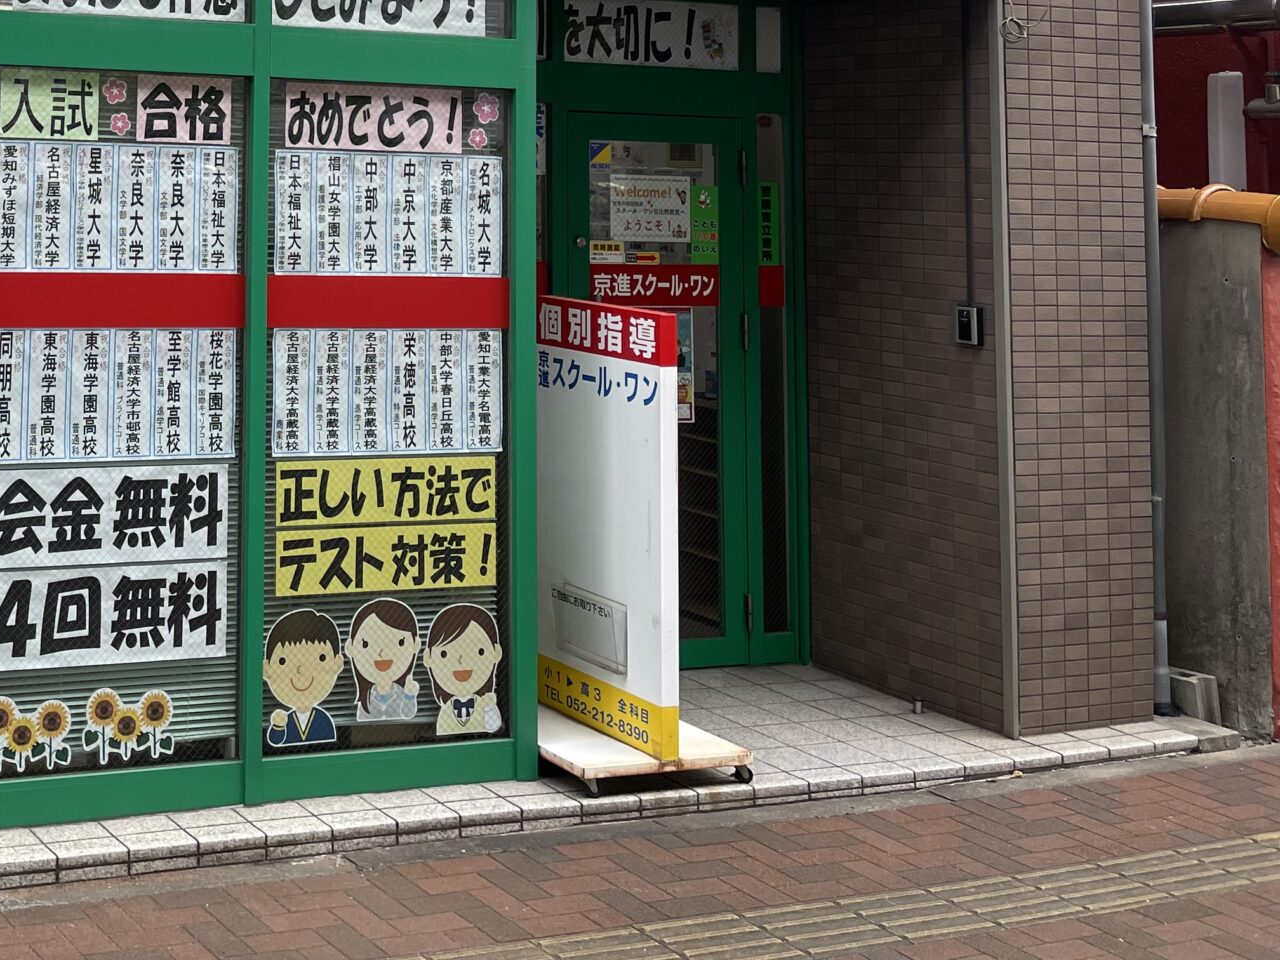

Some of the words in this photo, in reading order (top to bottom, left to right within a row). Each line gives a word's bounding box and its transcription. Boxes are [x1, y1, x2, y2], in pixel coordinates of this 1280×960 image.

[564, 2, 696, 62] を大切に！
[7, 77, 94, 139] 入試
[139, 80, 231, 143] 合格
[288, 90, 461, 149] おめでとう！
[0, 146, 17, 266] 愛知みずほ短期大学
[45, 147, 61, 266] 名古屋経済大学
[87, 148, 102, 267] 星城大学
[129, 149, 145, 267] 奈良大学
[170, 150, 185, 267] 奈良大学
[211, 151, 225, 268] 日本福祉大学
[288, 155, 301, 270] 日本福祉大学
[328, 156, 341, 270] 椙山女学園大学
[364, 157, 378, 270] 中部大学
[403, 159, 416, 271] 中京大学
[440, 160, 453, 271] 京都産業大学
[478, 161, 491, 272] 名城大学
[539, 303, 656, 359] 個別指導
[594, 272, 714, 298] 京進スクール・ワン
[40, 332, 57, 457] 東海学園高校
[82, 332, 99, 456] 東海学園高校
[126, 331, 141, 455] 名古屋経済大学市邨高校
[167, 332, 181, 453] 至学館高校
[209, 331, 223, 452] 桜花学園高校
[286, 332, 300, 451] 名古屋経済大学高蔵高校
[326, 332, 340, 450] 名古屋経済大学高蔵高校
[364, 333, 377, 449] 名古屋経済大学高蔵高校
[403, 333, 416, 448] 栄徳高校
[440, 332, 453, 448] 中部大学春日丘高校
[478, 332, 491, 446] 愛知工業大学名電高校
[278, 467, 491, 521] 正しい方法で
[278, 532, 491, 587] テスト対策！
[552, 588, 610, 618] ご自由にお取り下さい
[544, 685, 563, 704] TEL
[567, 695, 649, 744] 052-212-8390
[618, 699, 649, 724] 全科目
